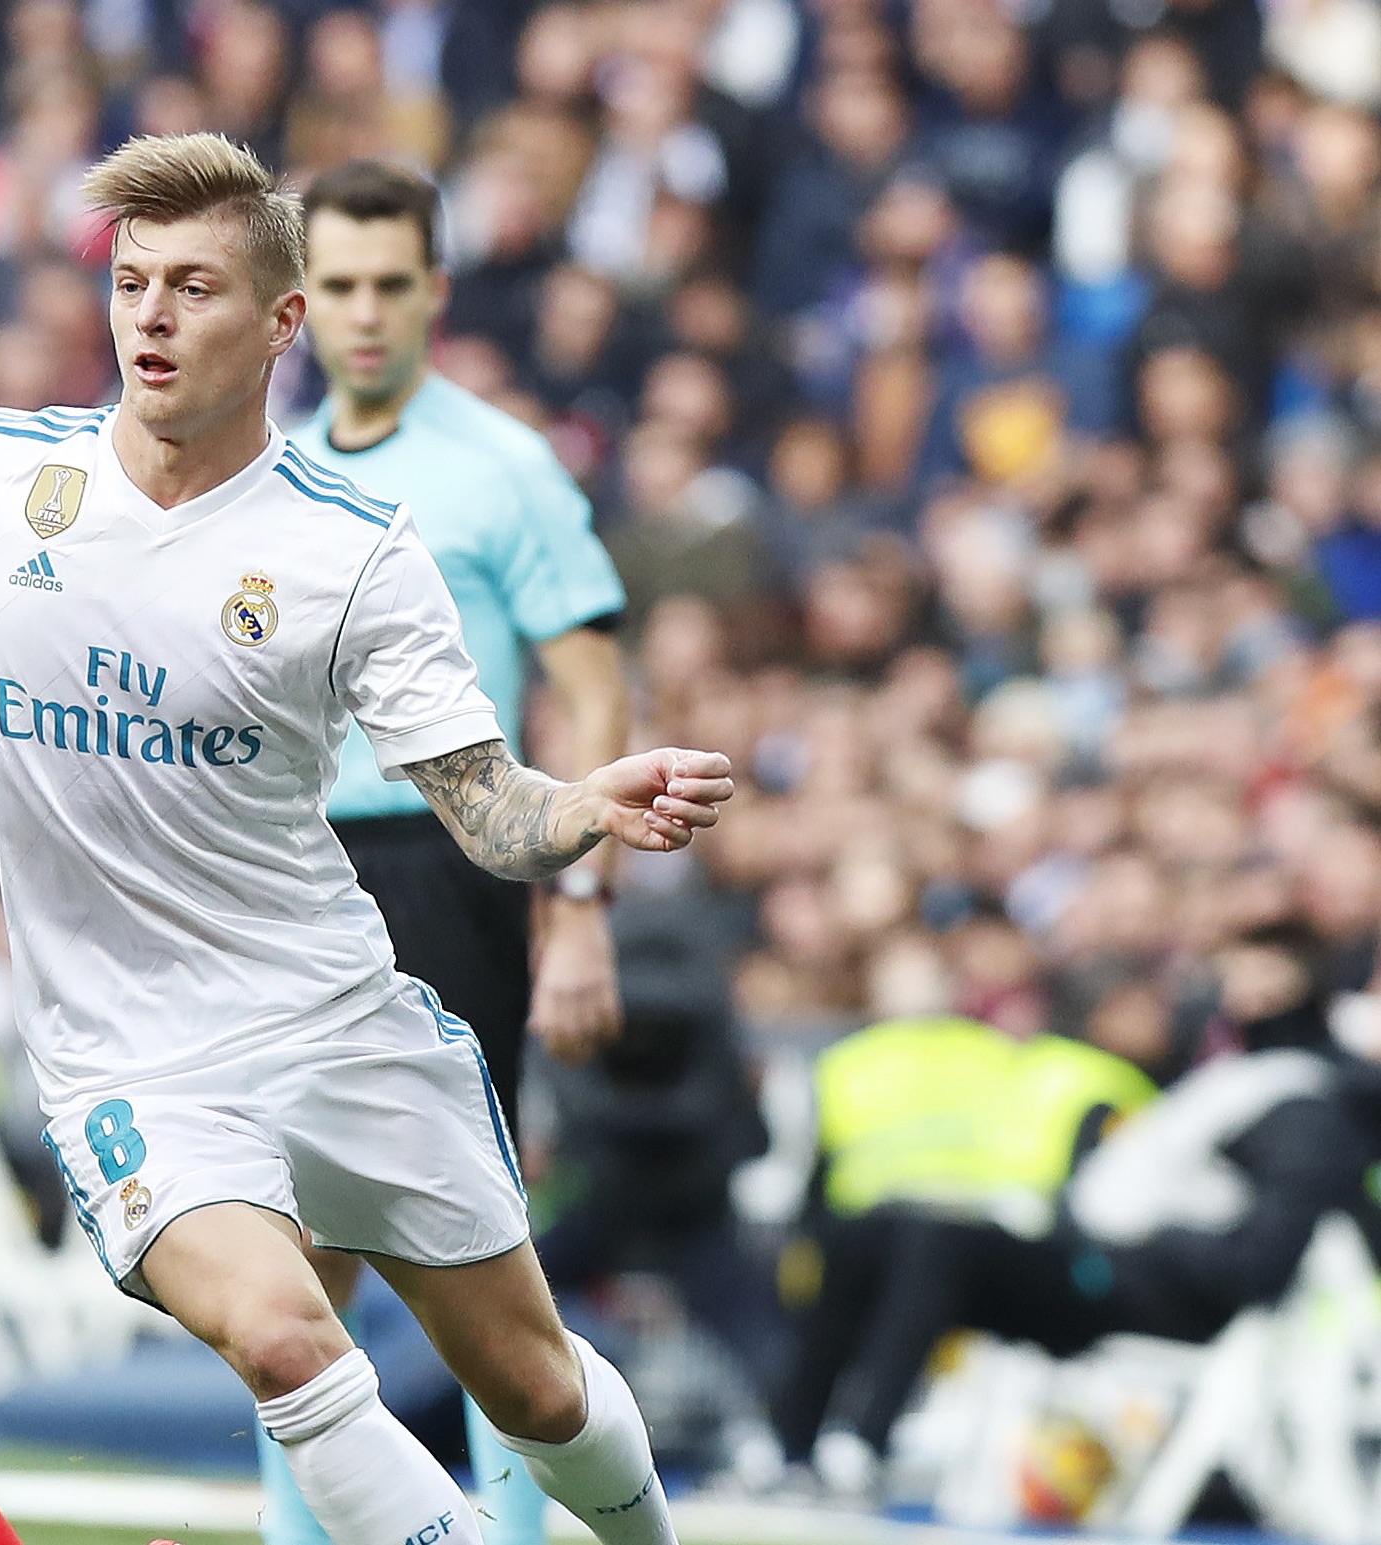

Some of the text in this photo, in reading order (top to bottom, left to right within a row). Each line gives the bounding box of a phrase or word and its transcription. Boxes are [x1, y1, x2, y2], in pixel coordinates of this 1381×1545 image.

[36, 508, 64, 524] FIFA
[8, 572, 64, 593] adidas
[87, 645, 167, 707] Fly
[84, 1098, 147, 1186] 8
[405, 1510, 454, 1545] CF
